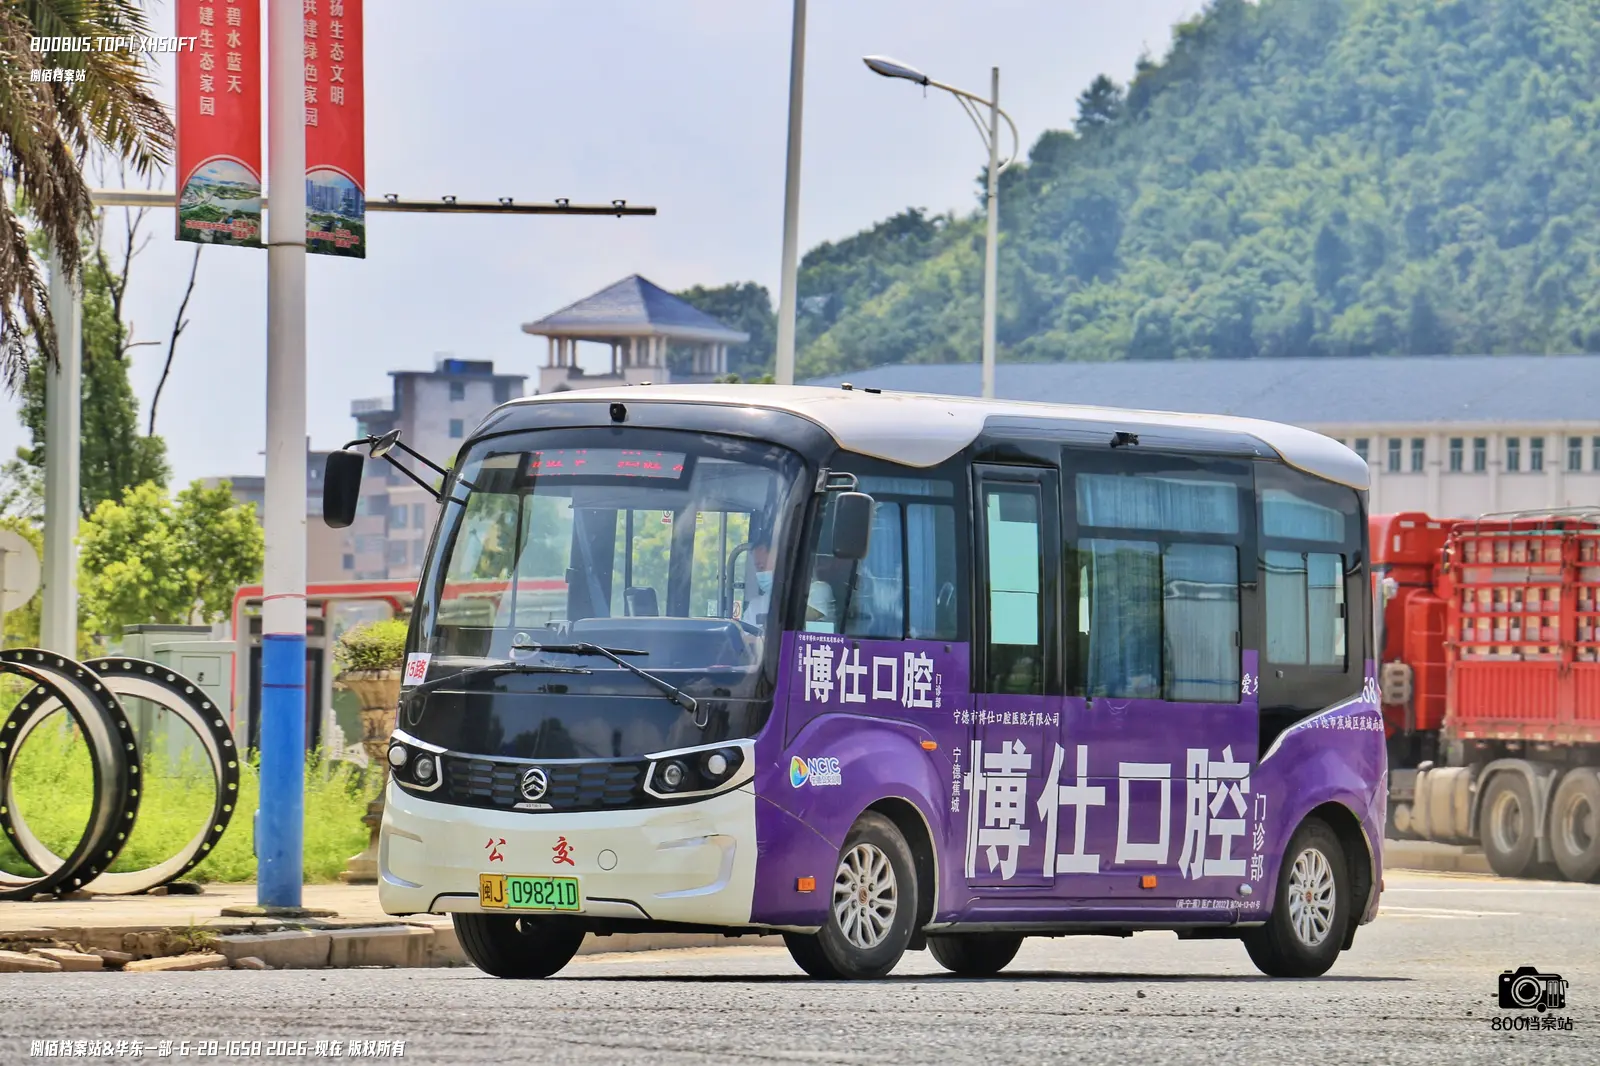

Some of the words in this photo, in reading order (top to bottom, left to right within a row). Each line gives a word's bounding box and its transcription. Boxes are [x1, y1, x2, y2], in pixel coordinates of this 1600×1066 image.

[199, 0, 215, 116] 建生态家园
[226, 0, 242, 94] 碧水蓝天
[406, 659, 427, 679] 15路
[803, 644, 934, 709] 博仕口腔
[953, 709, 1060, 727] 宁德市博仕口腔医院有限公司
[807, 757, 841, 774] NCIC
[950, 747, 961, 812] 宁德蕉城
[963, 738, 1250, 881] 博仕口腔
[1250, 793, 1267, 882] 门诊部
